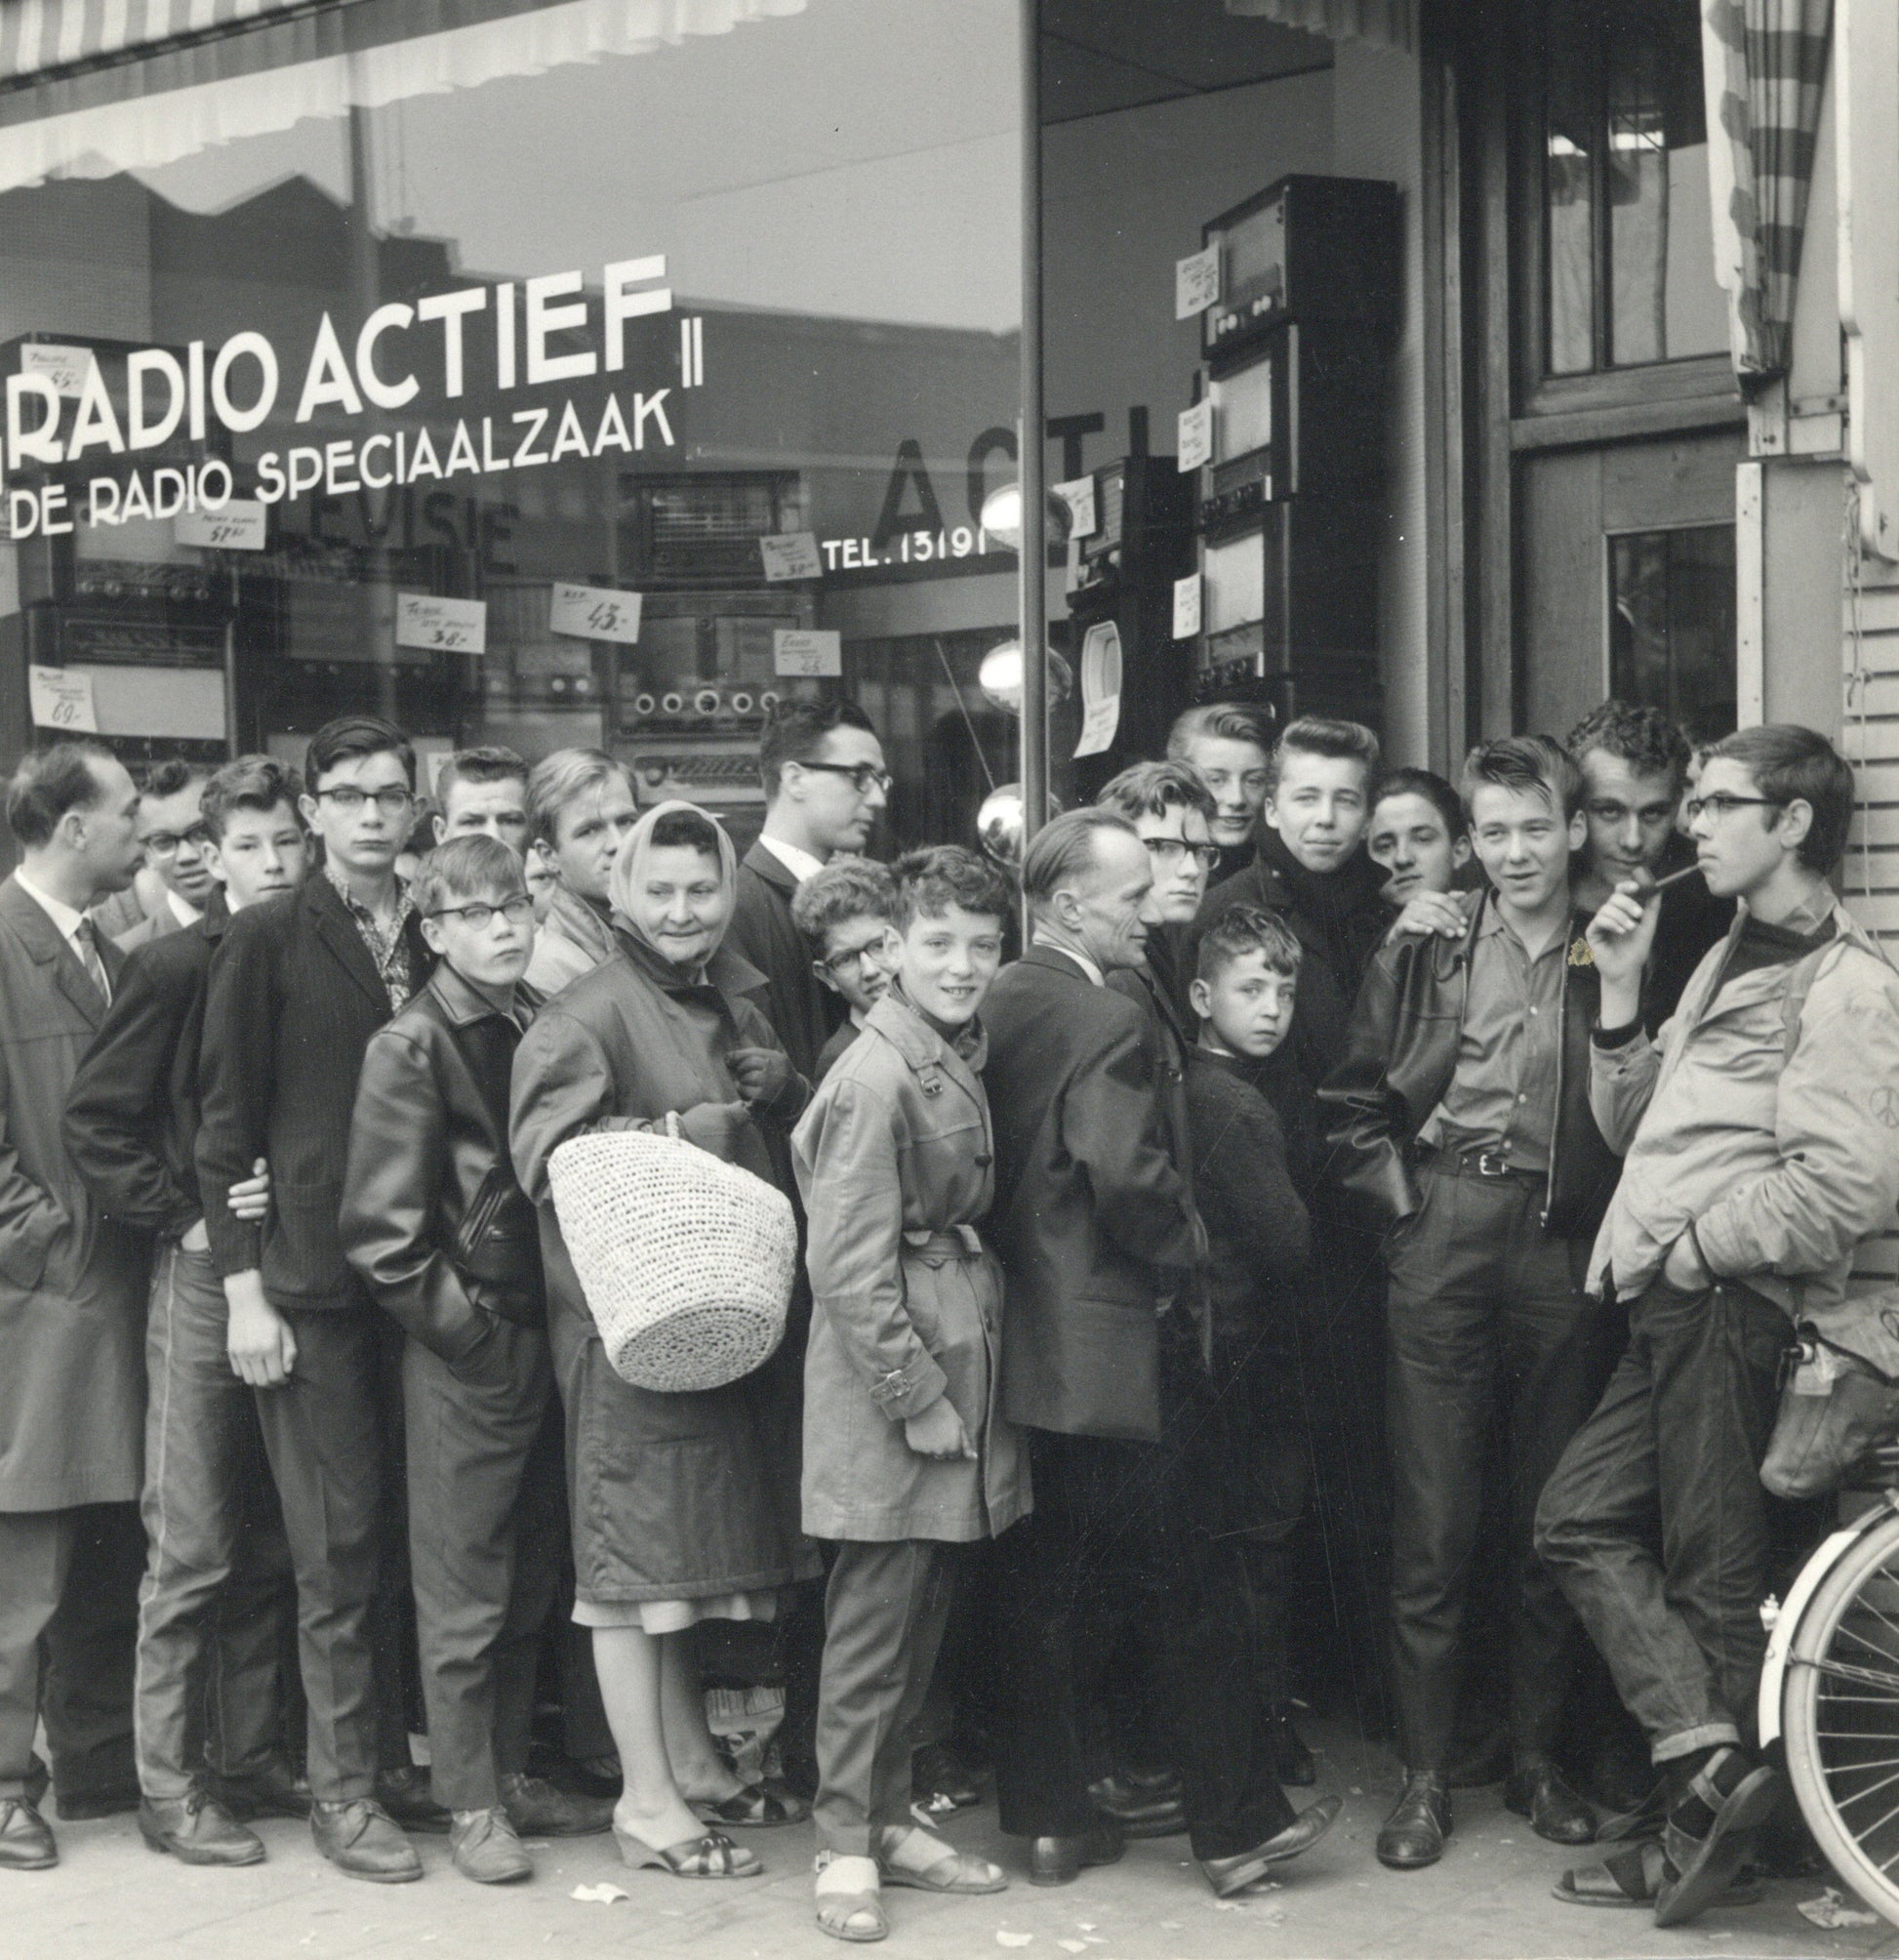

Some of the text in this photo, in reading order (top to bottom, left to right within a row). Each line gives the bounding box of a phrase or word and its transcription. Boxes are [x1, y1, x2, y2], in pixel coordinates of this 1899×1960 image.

[7, 331, 279, 470] RADIO
[295, 254, 672, 424] ACTIEF
[9, 388, 675, 540] DE RADIO SPECIAALZAAK
[900, 523, 988, 564] 13191
